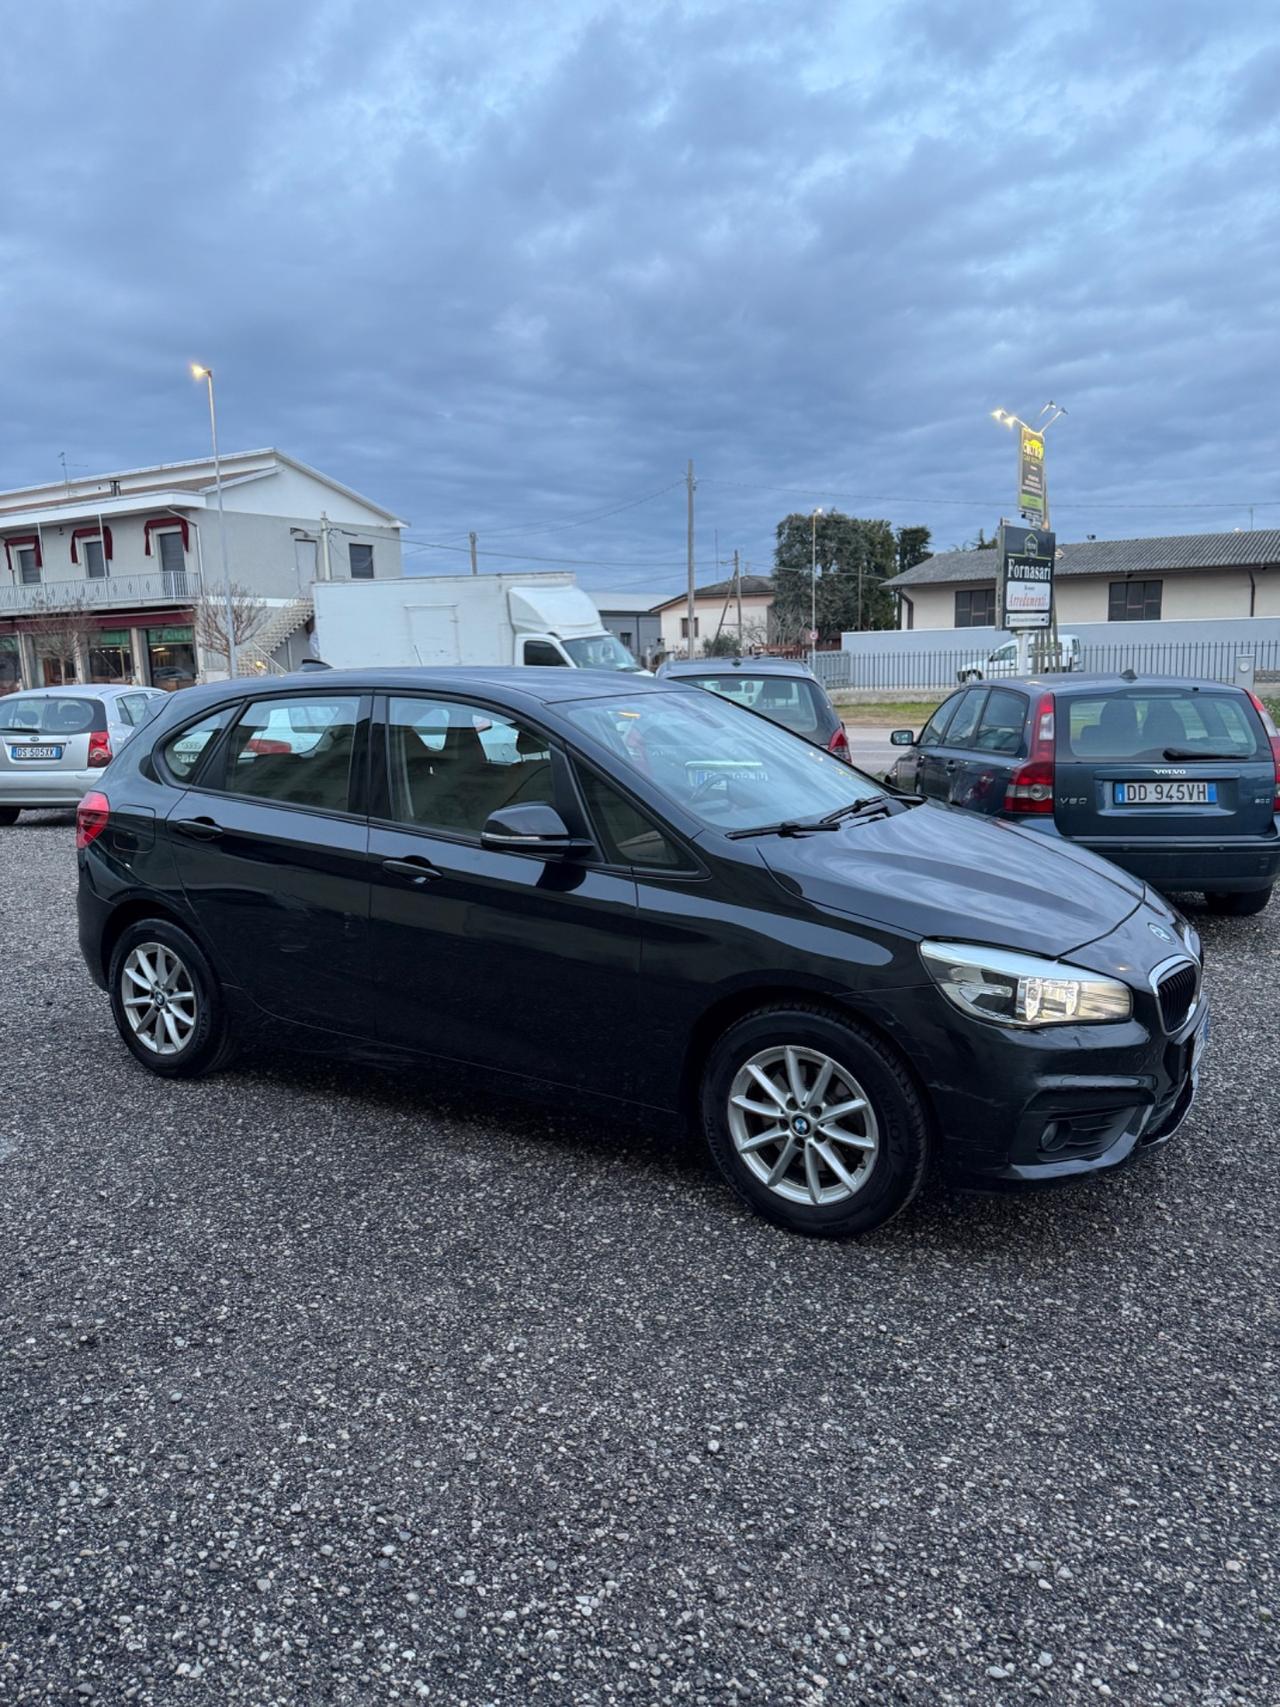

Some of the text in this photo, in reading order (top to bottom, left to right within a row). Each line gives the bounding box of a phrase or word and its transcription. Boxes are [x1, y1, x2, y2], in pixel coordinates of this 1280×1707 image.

[1008, 559, 1051, 580] Fornasari
[17, 747, 27, 757] DS
[1127, 784, 1206, 801] DD 945VH
